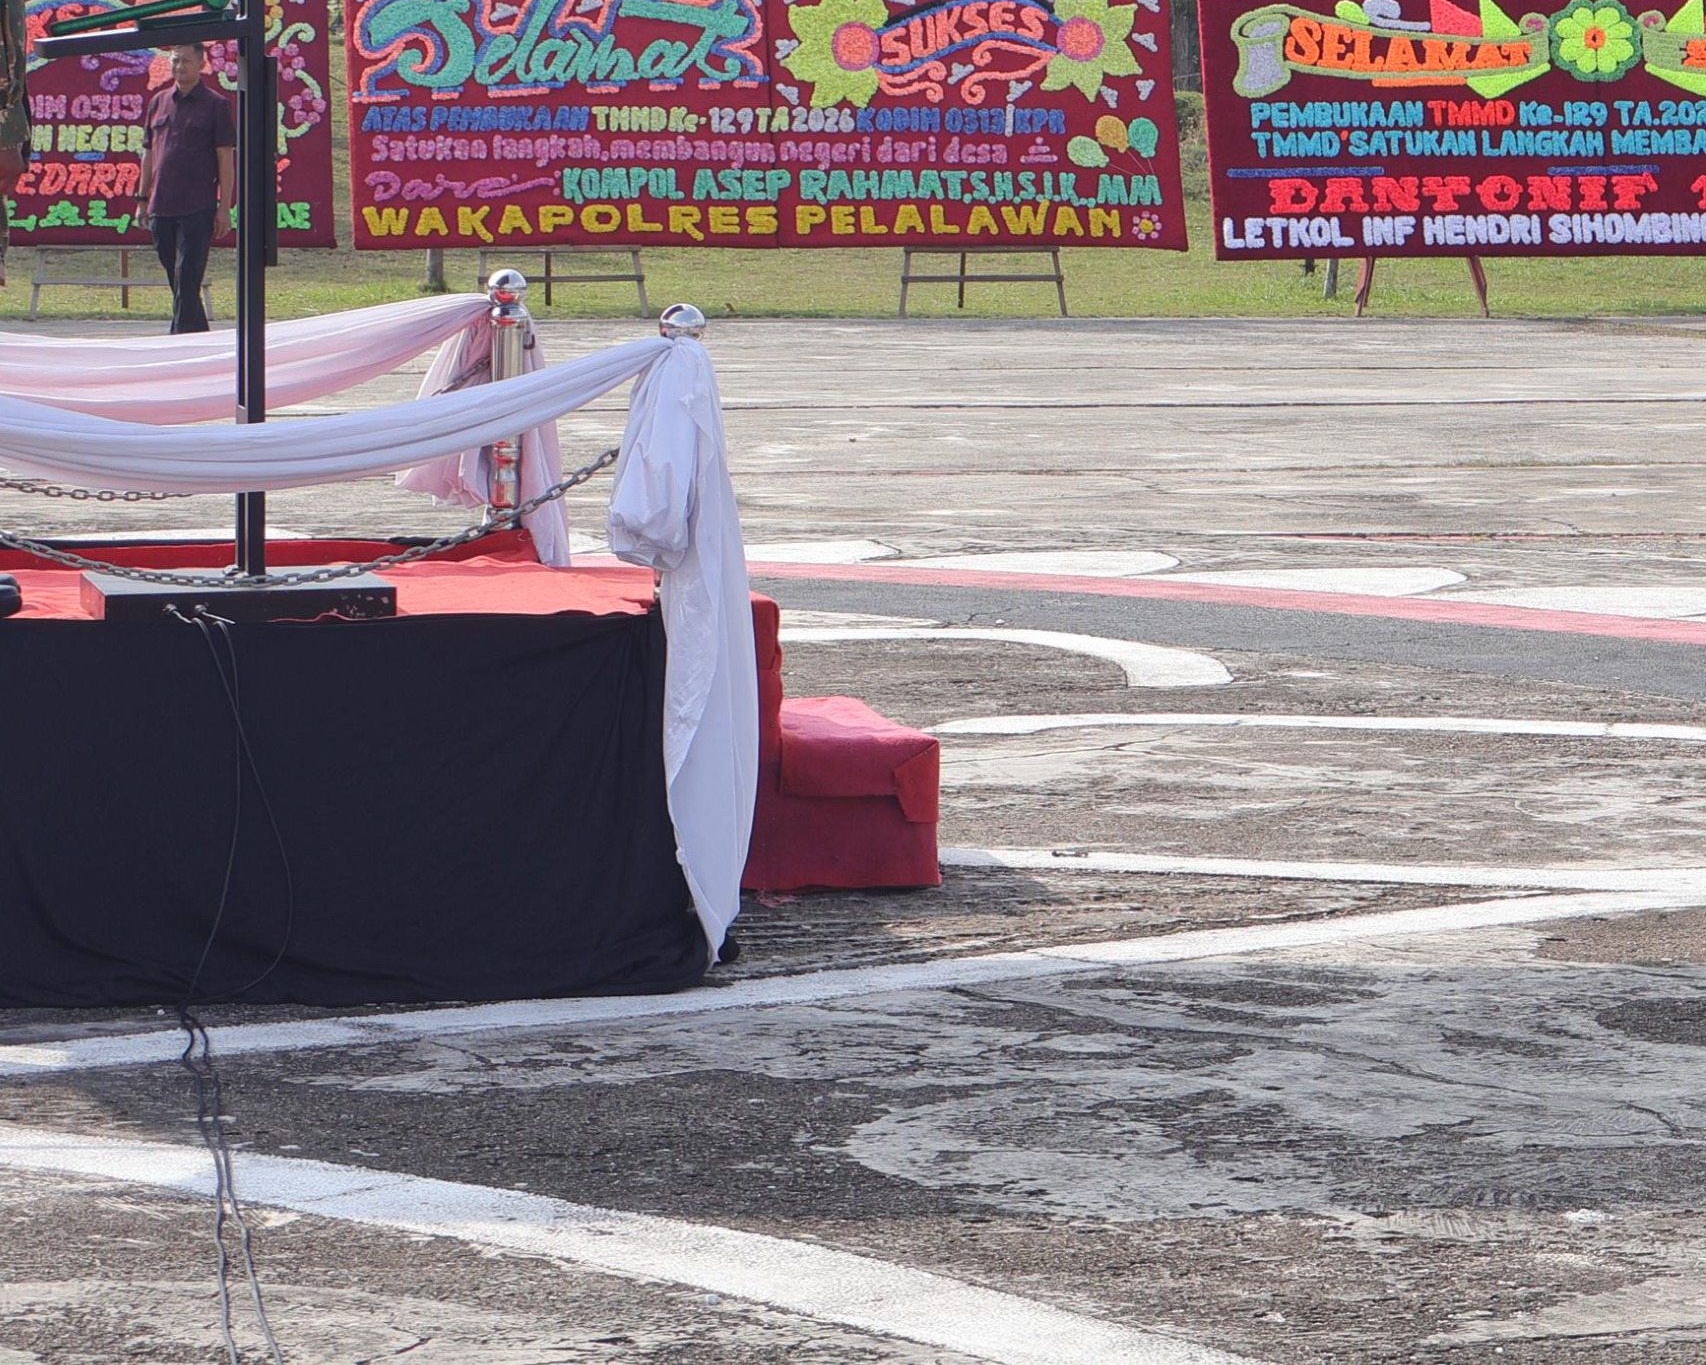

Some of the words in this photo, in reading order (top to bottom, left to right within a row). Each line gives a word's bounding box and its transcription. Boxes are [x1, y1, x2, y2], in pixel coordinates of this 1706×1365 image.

[879, 1, 1050, 67] SUKSES
[1285, 16, 1533, 73] SELAMAT
[361, 105, 427, 133] ATAS
[755, 106, 789, 134] TA
[791, 105, 855, 133] 2026
[855, 107, 940, 133] KODIM
[1250, 100, 1424, 129] PEMBUKAAN
[1427, 99, 1515, 127] TMMD
[57, 124, 146, 158] NEGER
[371, 134, 488, 163] Satukan
[780, 136, 871, 171] negeri
[876, 136, 937, 164] dari
[943, 136, 1008, 164] desa
[1481, 129, 1605, 157] LANGKAH
[15, 162, 140, 199] EDARA
[563, 167, 685, 205] KOMPOL
[693, 168, 792, 201] ASEP
[361, 203, 779, 243] WAKAPOLRES
[795, 199, 1122, 238] PELALAWAN
[1222, 216, 1355, 249] LETKOL
[1362, 215, 1416, 248] INF
[1422, 214, 1542, 246] HENDRI
